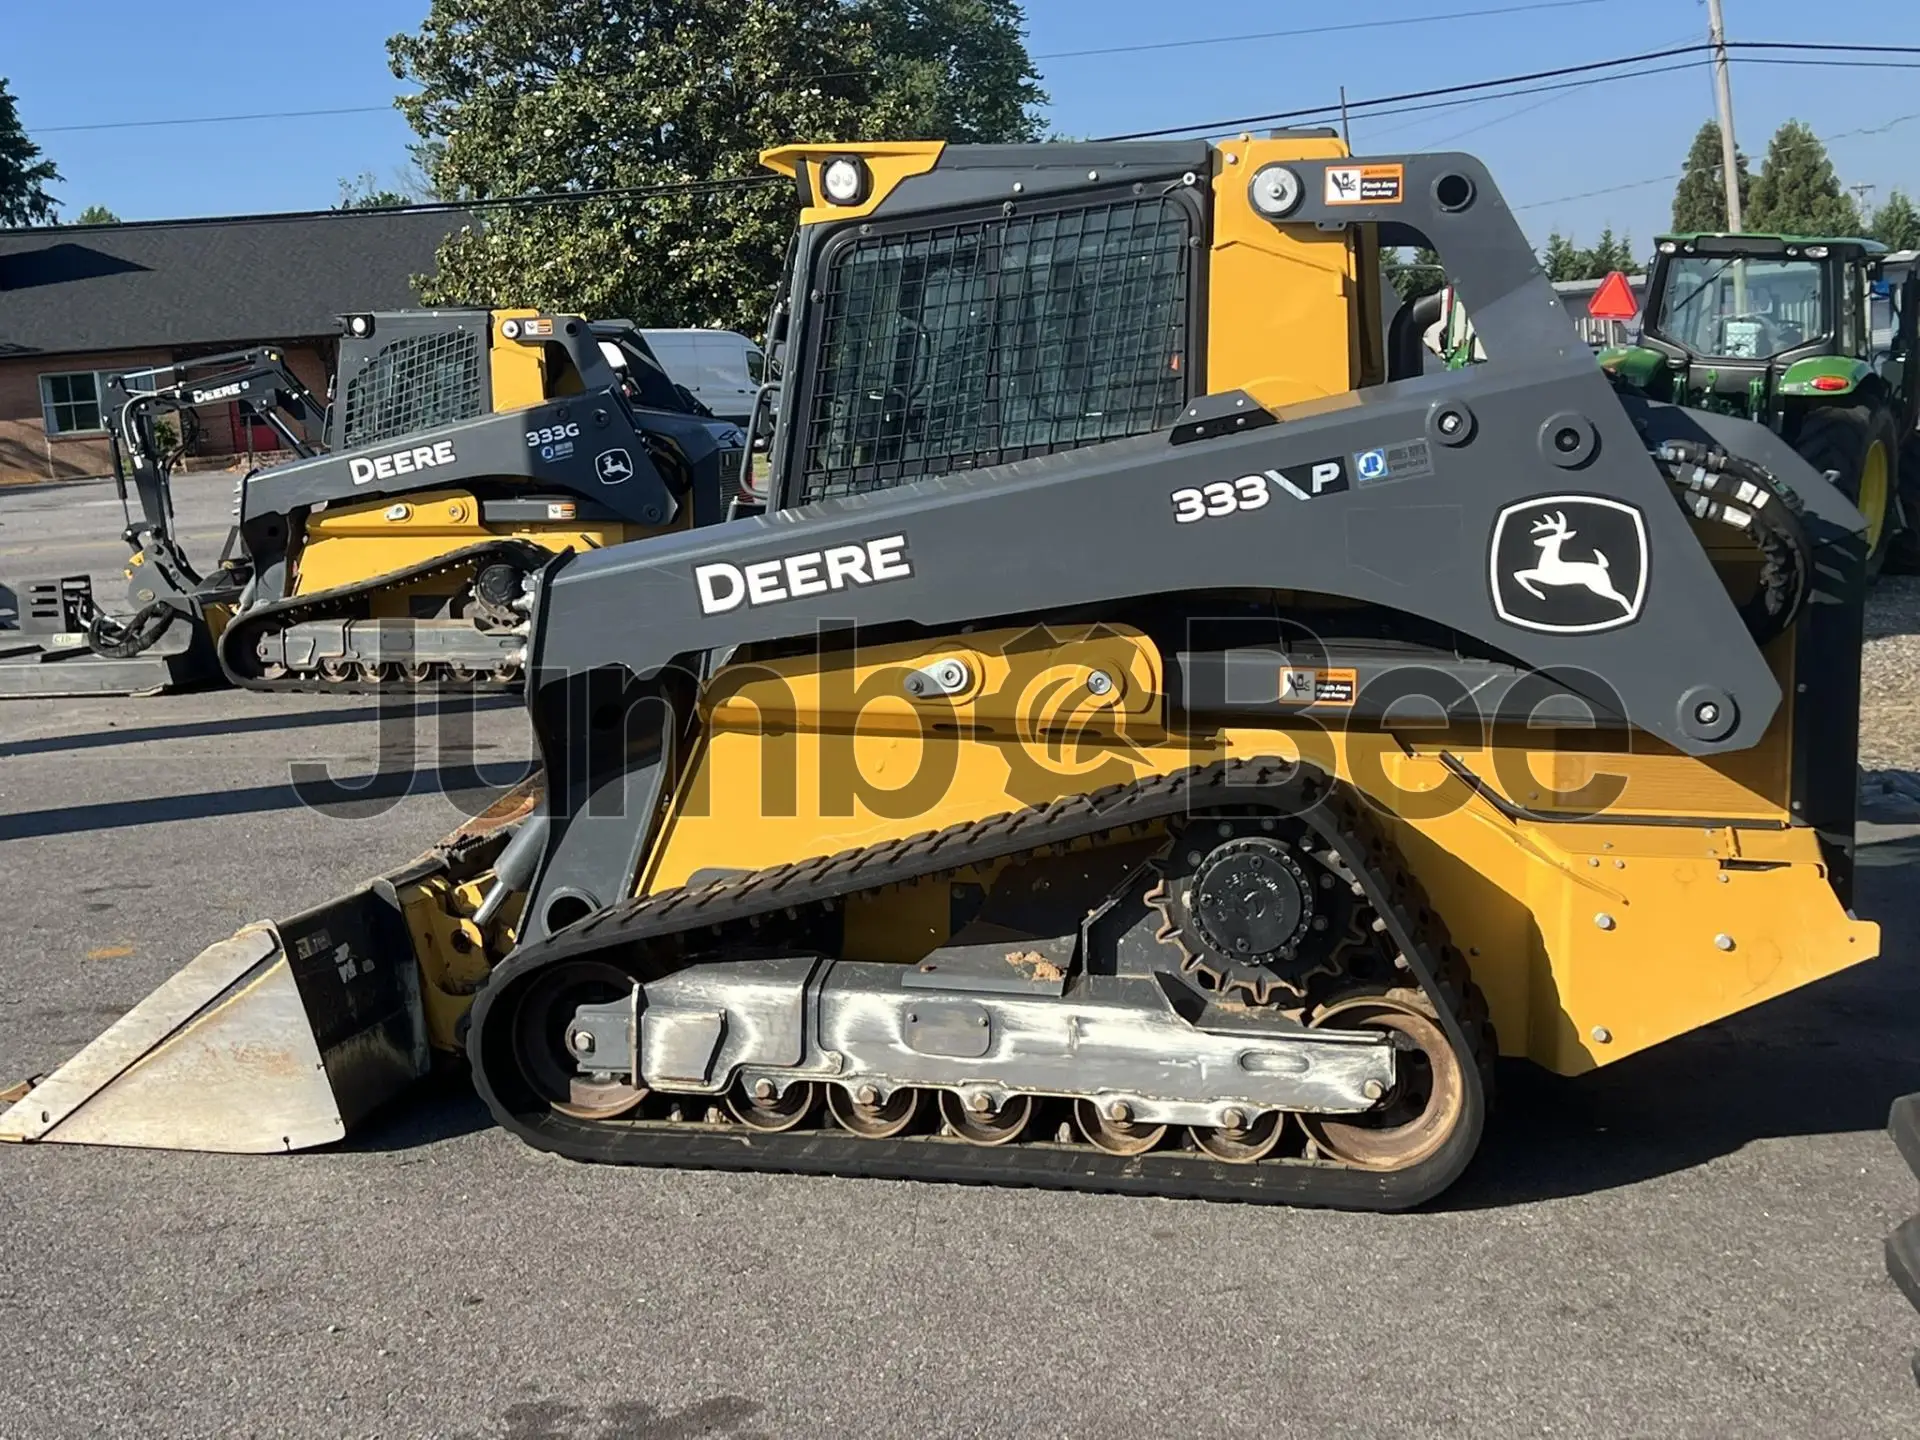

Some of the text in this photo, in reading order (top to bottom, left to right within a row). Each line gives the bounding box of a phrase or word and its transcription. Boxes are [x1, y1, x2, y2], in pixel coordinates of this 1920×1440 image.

[193, 383, 241, 403] DEERE
[526, 423, 580, 447] 333G
[349, 441, 456, 485] DEERE
[695, 535, 911, 614] DEERE
